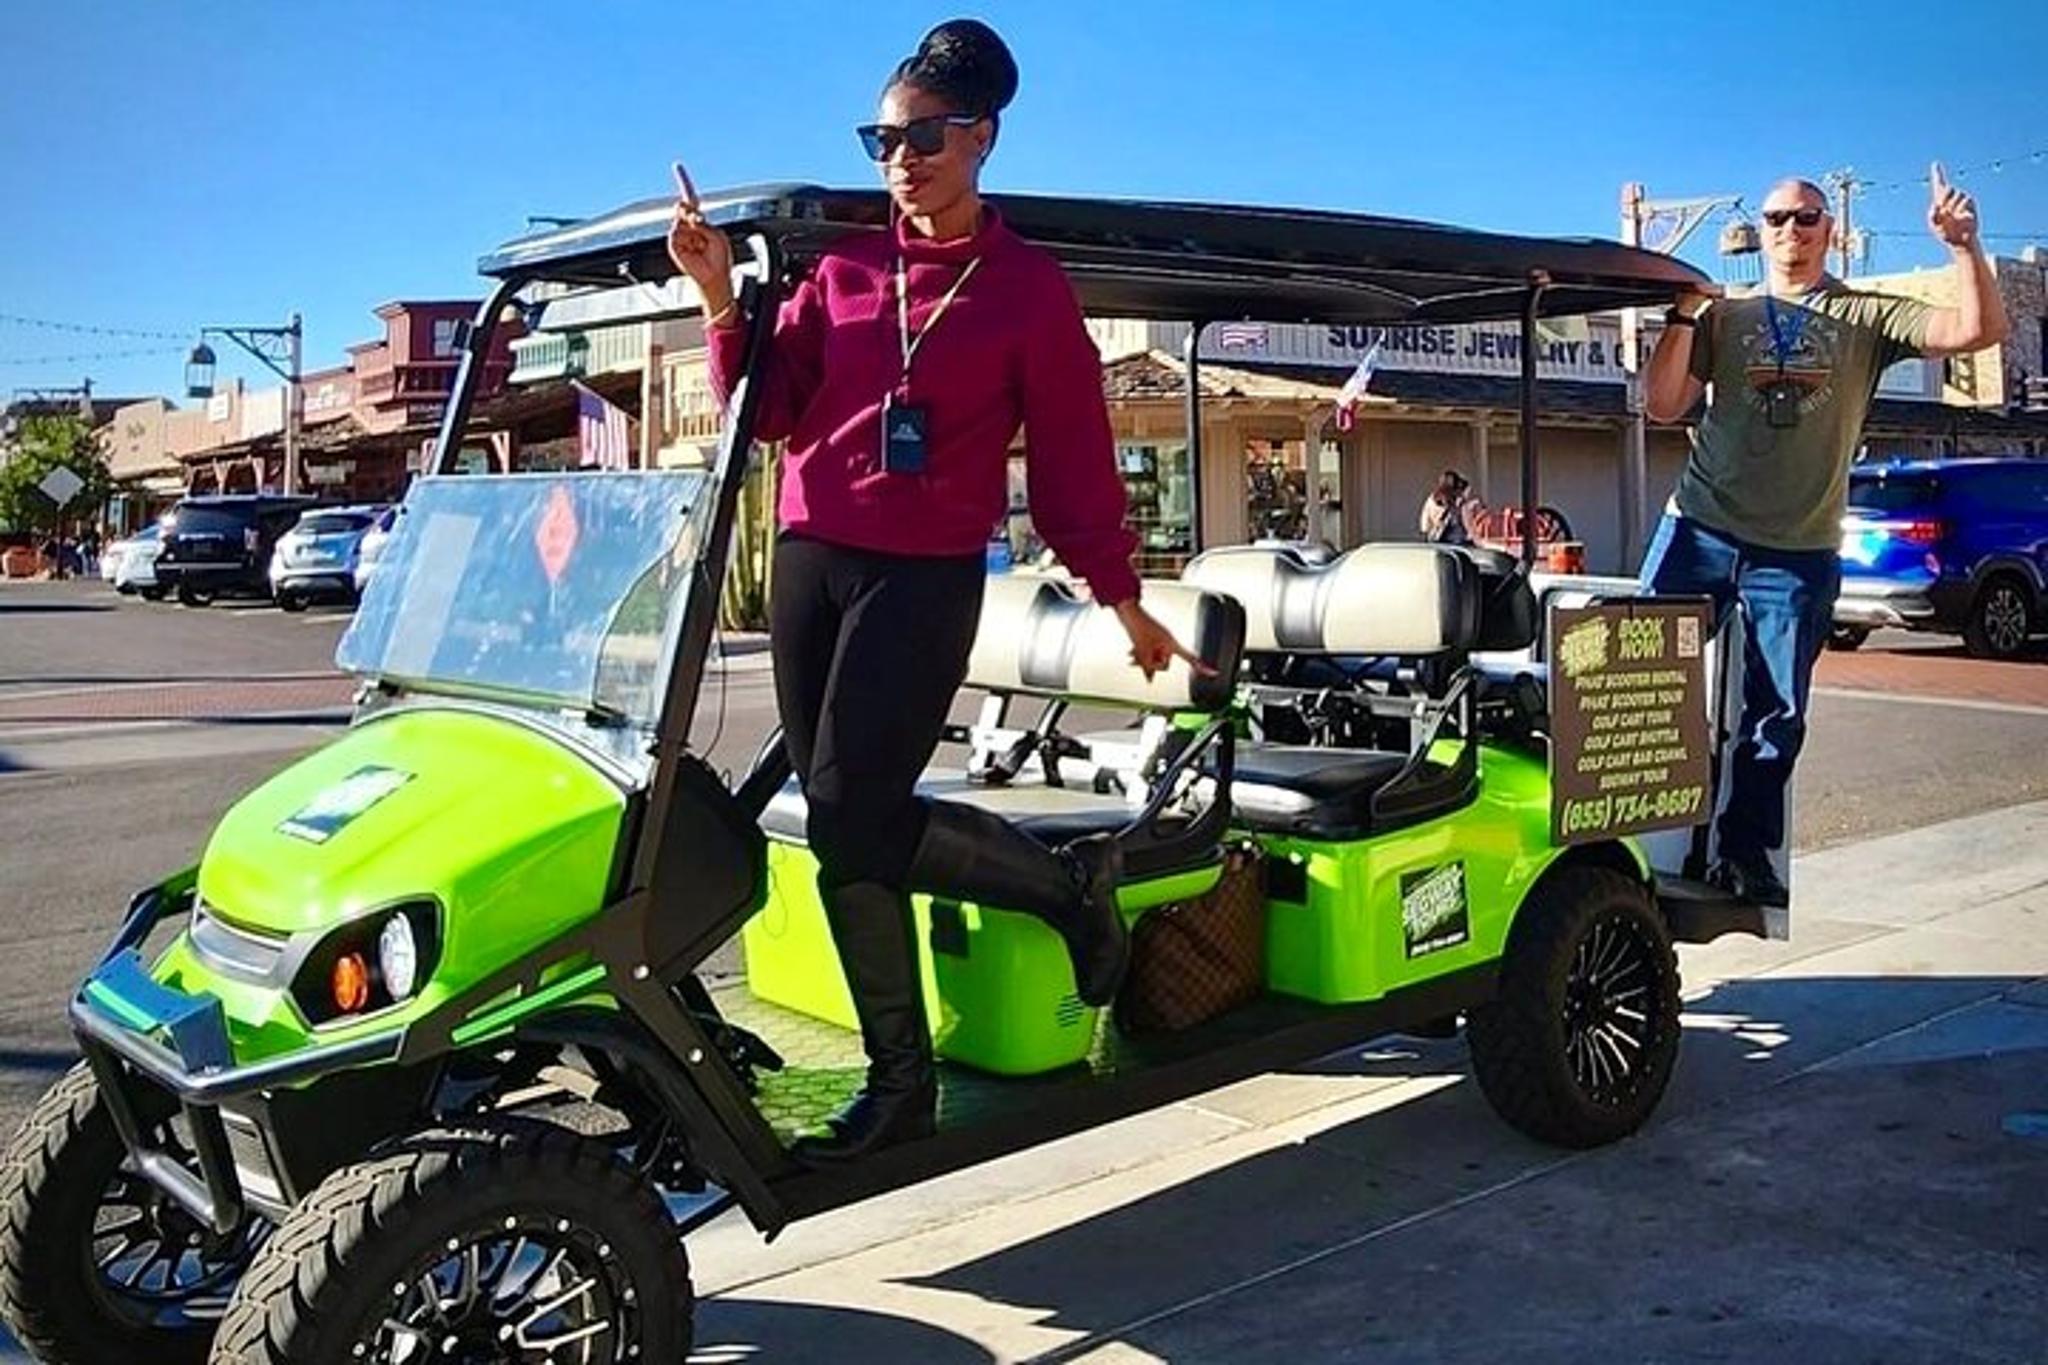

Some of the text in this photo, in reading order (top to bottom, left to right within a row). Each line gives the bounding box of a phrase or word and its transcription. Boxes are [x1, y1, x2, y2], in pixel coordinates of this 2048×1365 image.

[1588, 341, 1605, 365] &
[1619, 617, 1664, 639] BOOK
[1592, 714, 1619, 729] GOLF
[1620, 712, 1645, 728] CART
[1584, 734, 1611, 751] GOLF
[1612, 731, 1639, 749] CART
[1578, 754, 1605, 772] GOLF
[1605, 752, 1631, 769] CART
[1562, 795, 1612, 836] (855)
